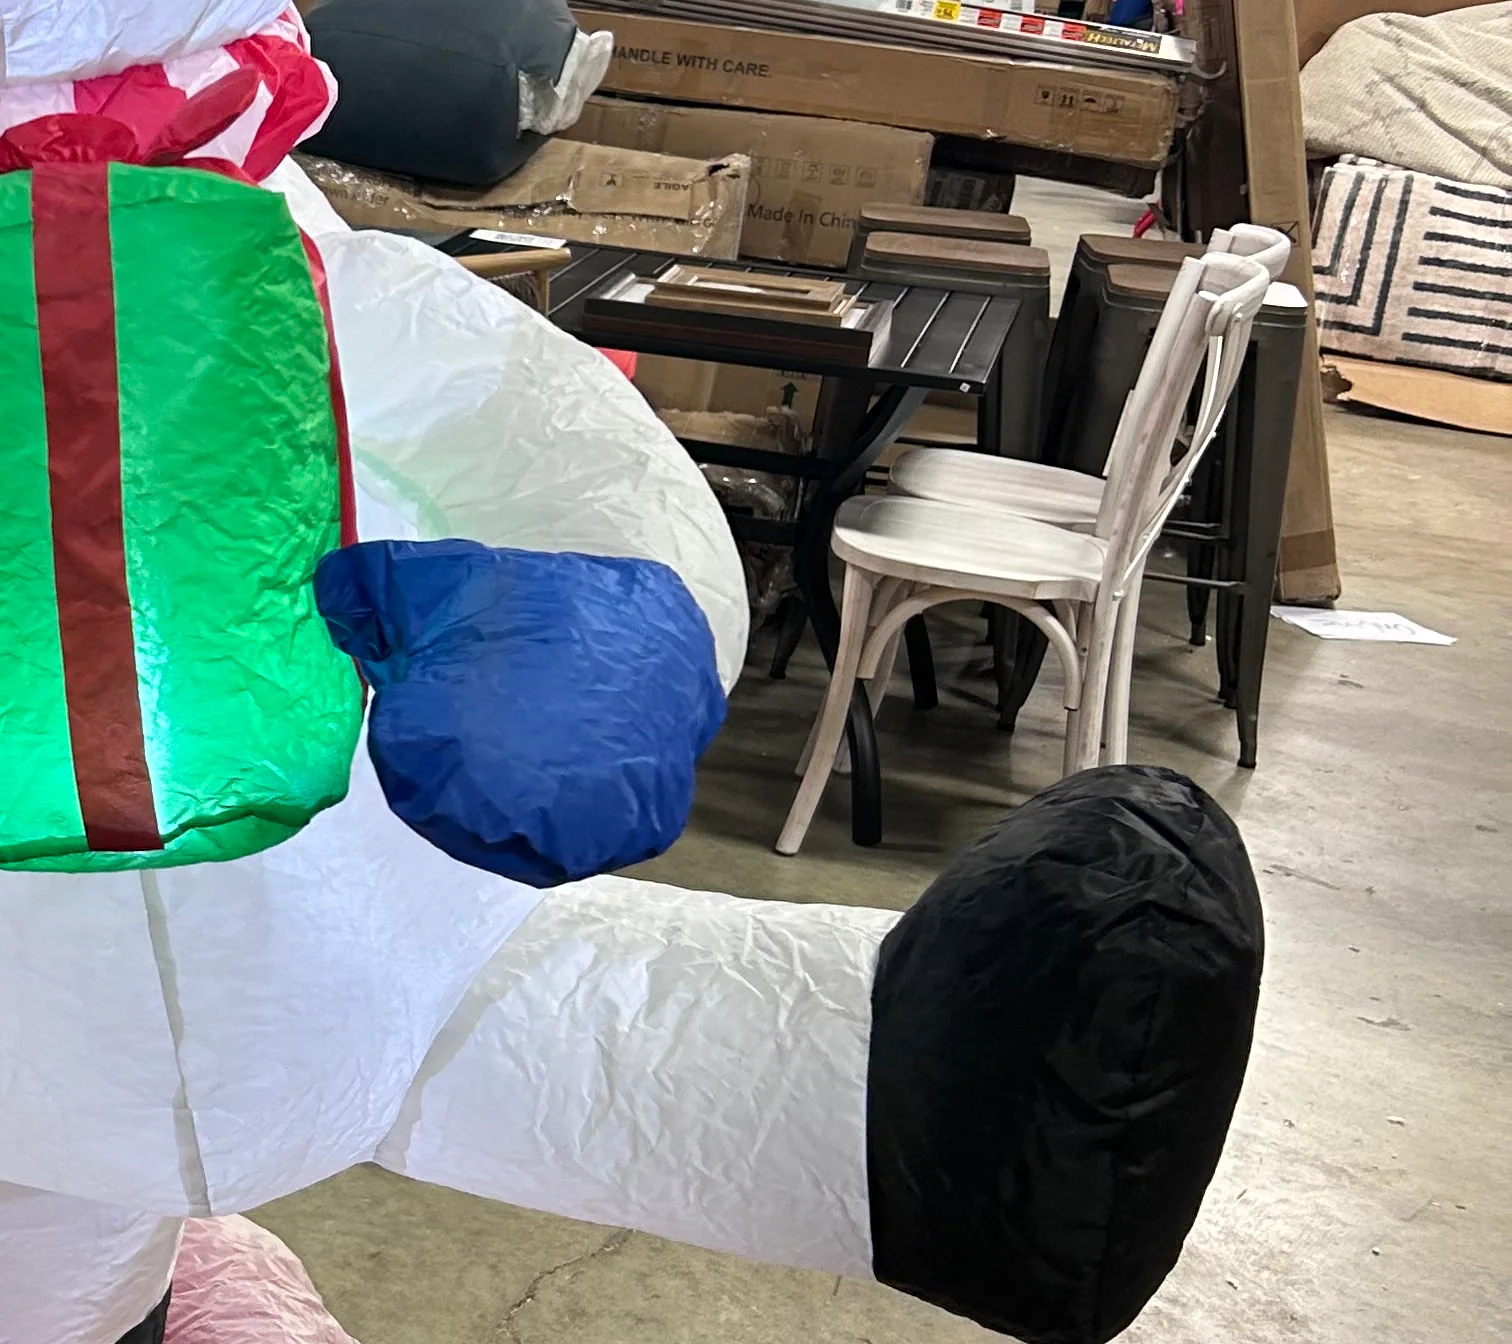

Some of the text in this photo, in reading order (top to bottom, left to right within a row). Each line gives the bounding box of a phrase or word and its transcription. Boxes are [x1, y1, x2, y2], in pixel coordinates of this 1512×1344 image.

[676, 53, 718, 70] WITH
[746, 203, 857, 228] Made In Chin
